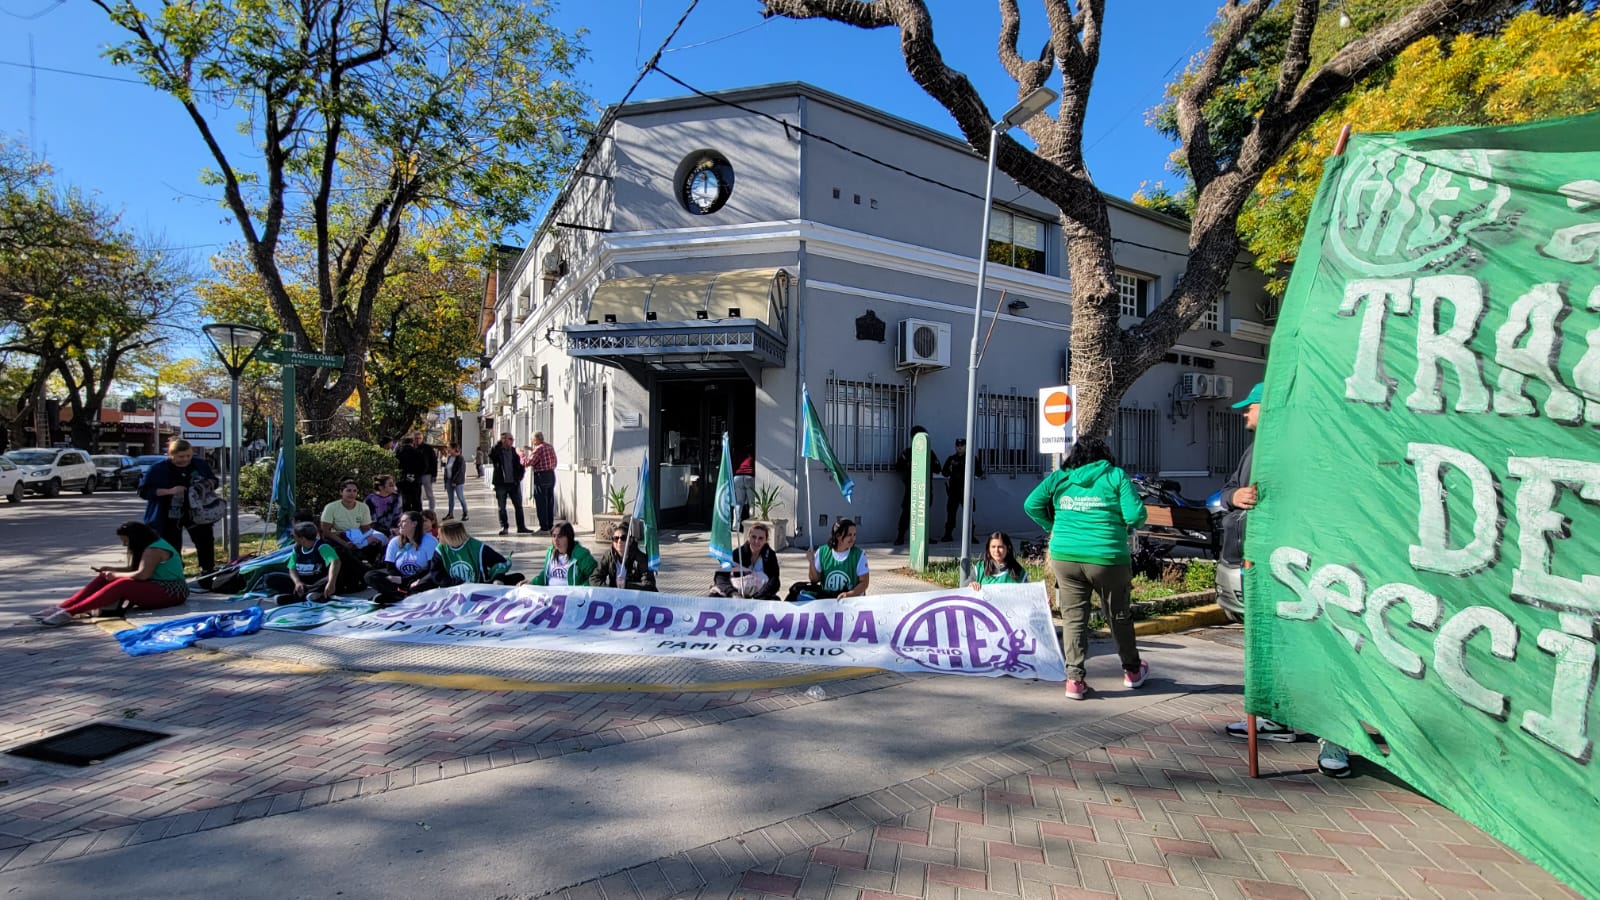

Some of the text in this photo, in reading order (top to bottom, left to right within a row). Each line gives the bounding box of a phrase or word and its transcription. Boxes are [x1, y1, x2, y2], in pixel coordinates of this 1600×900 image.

[291, 352, 336, 361] ANGELOME
[577, 599, 674, 635] POR
[688, 610, 879, 644] ROMINA
[903, 605, 1004, 668] ATE
[657, 640, 845, 657] PAMI ROSARIO
[898, 646, 963, 656] OSARIO
